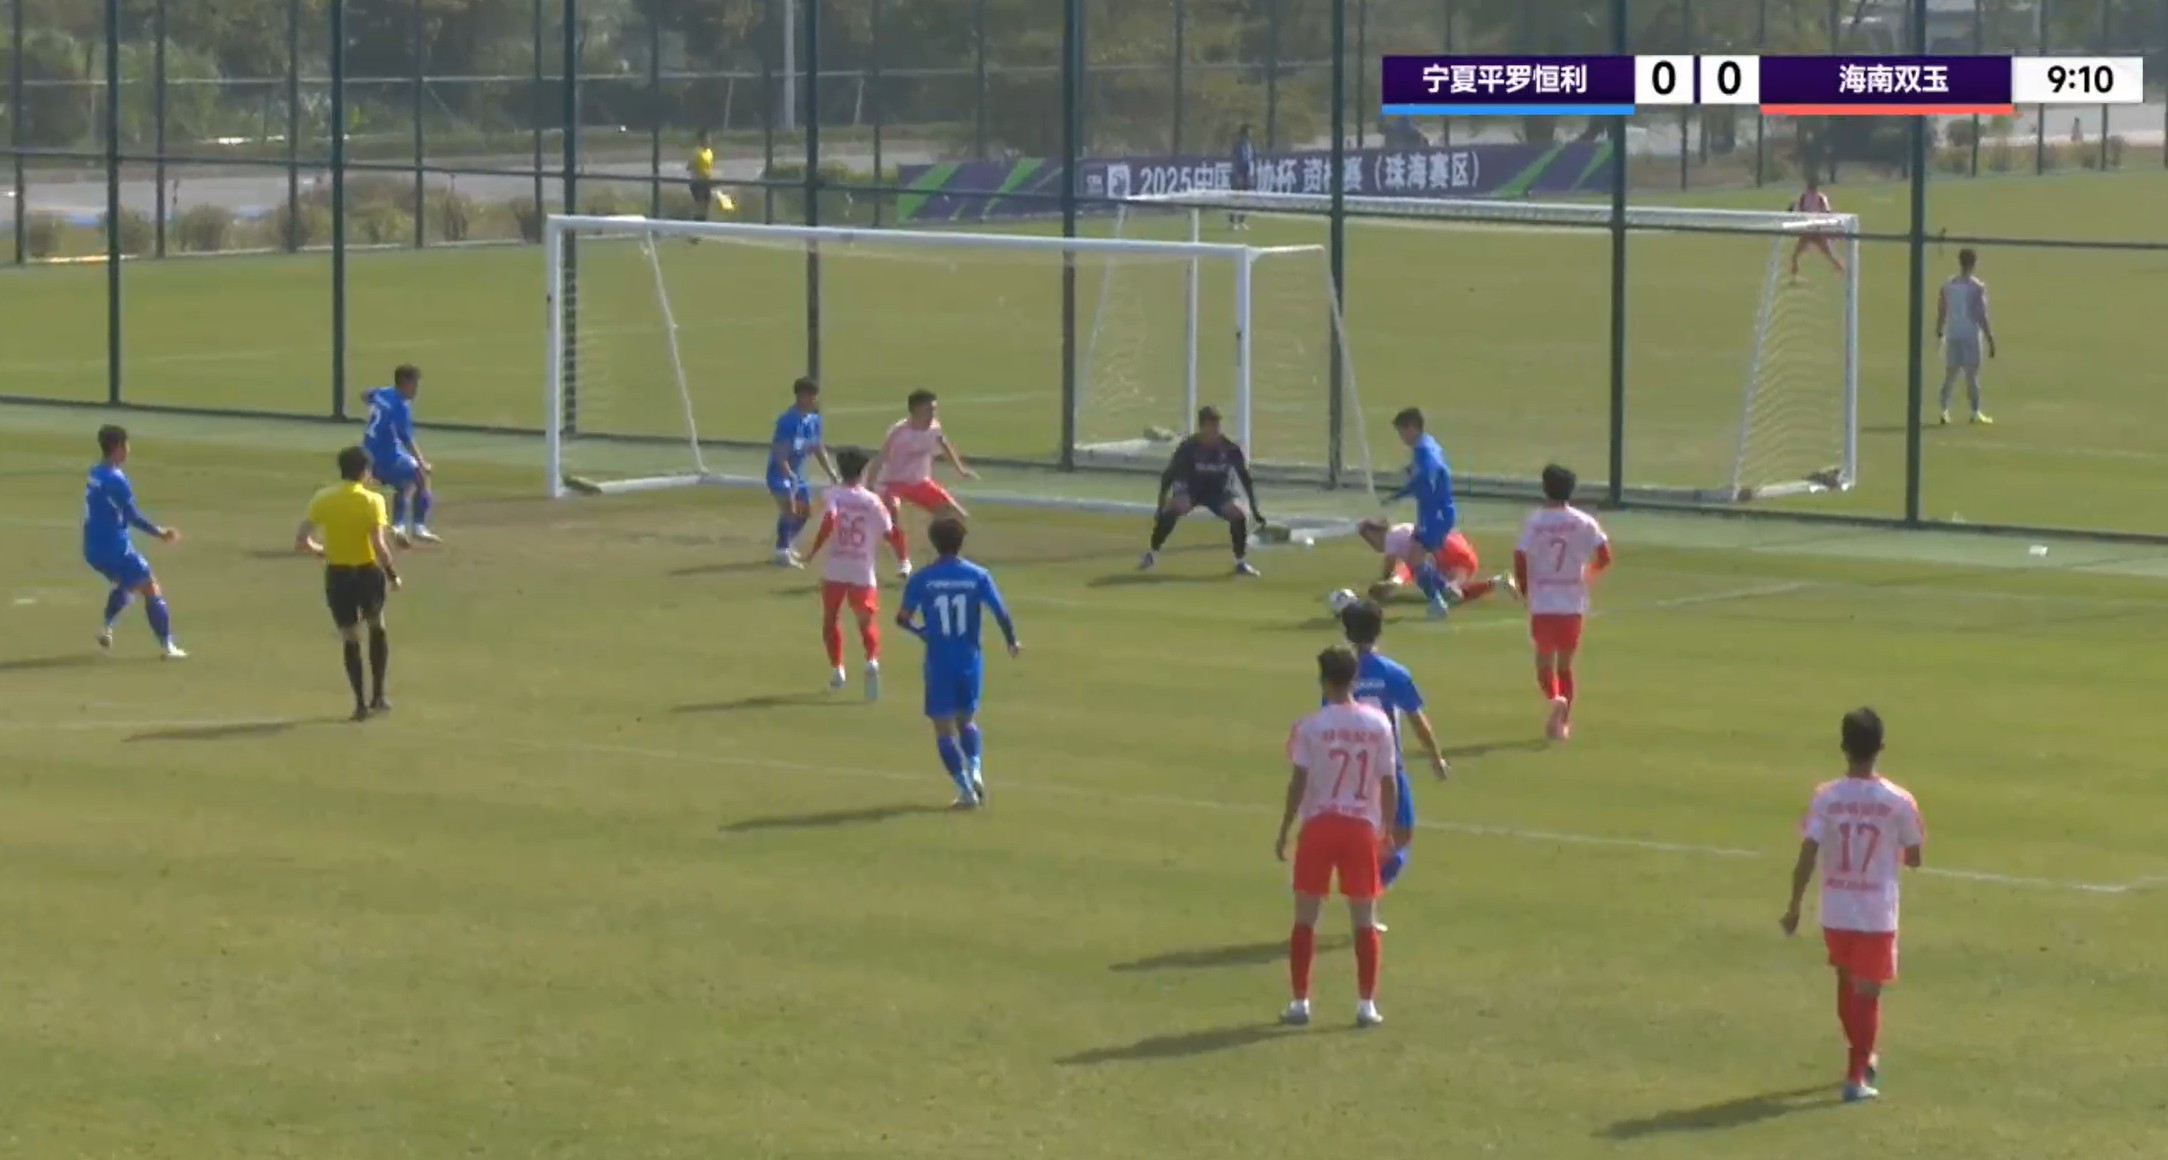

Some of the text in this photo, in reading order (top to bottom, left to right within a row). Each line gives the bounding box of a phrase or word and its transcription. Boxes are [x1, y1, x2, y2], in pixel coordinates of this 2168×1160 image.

[1550, 538, 1567, 573] 7
[934, 593, 968, 638] 11
[1329, 748, 1369, 801] 71
[1838, 822, 1881, 874] 17
